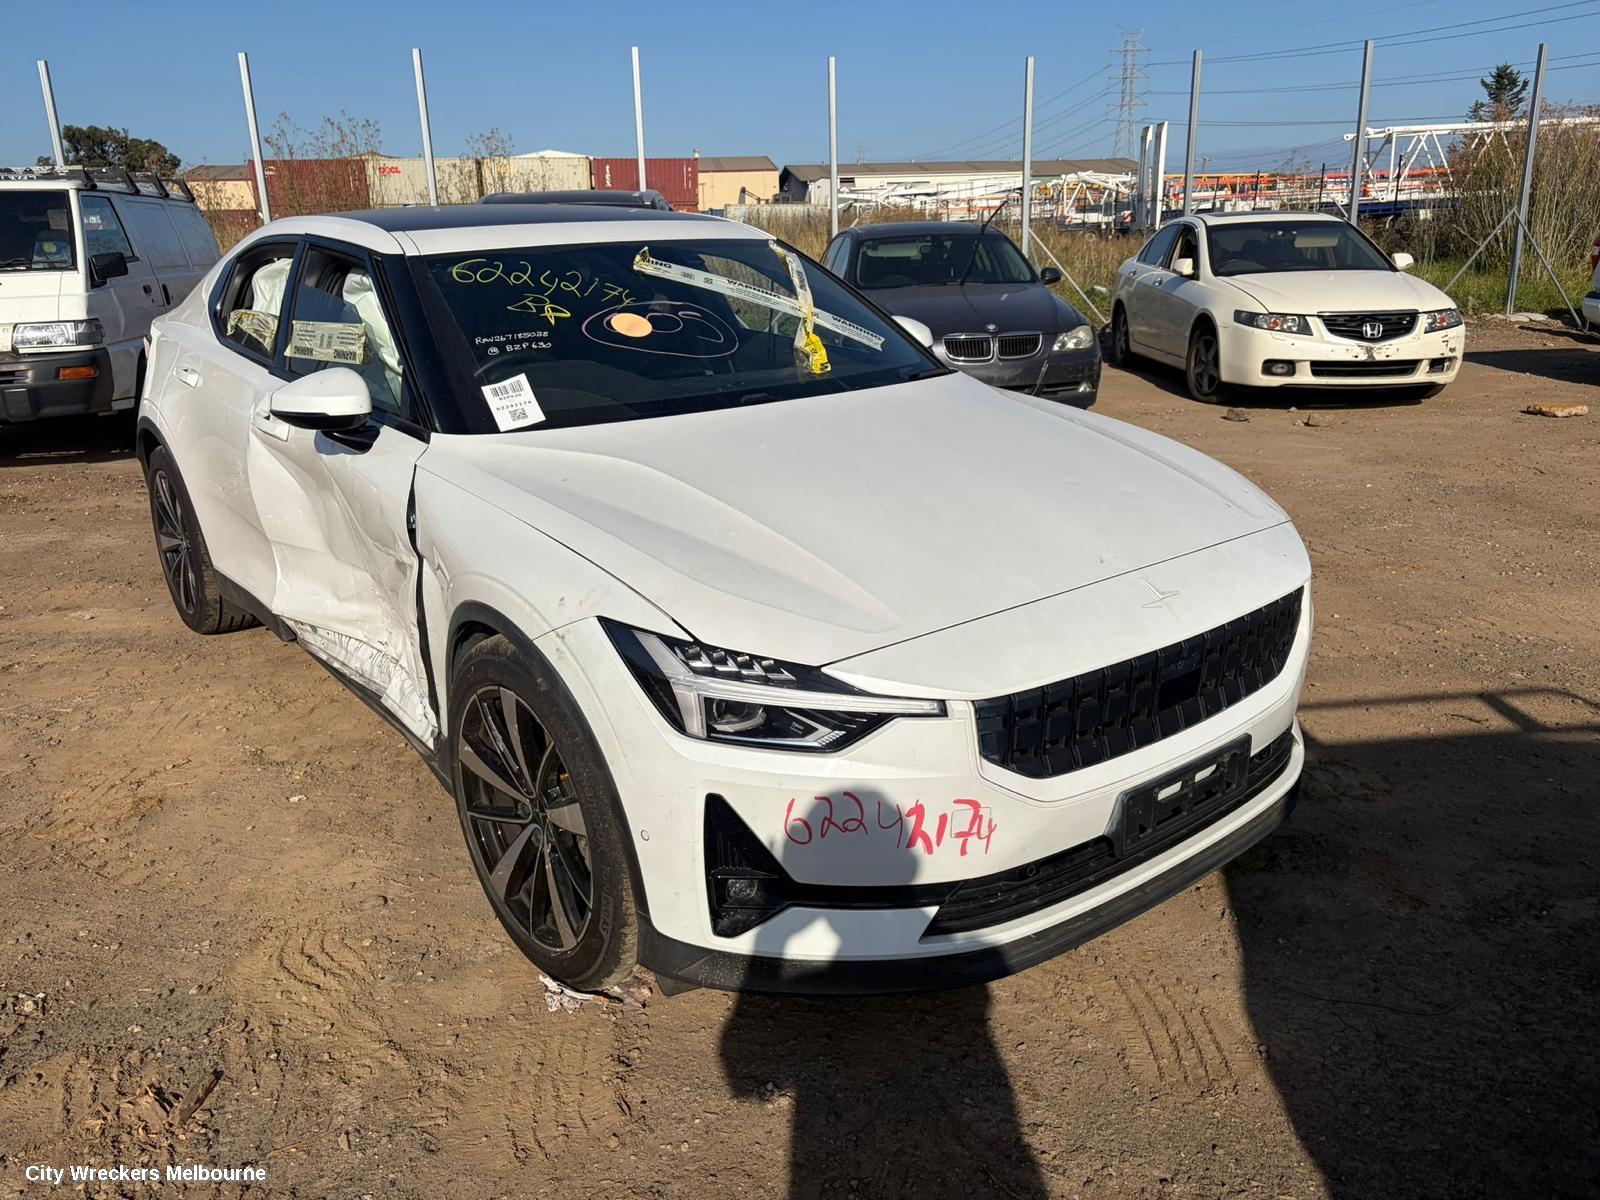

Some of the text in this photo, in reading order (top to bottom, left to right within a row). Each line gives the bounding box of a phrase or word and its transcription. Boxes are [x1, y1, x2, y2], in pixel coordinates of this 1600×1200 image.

[452, 258, 636, 310] 62242174
[727, 279, 782, 299] WARNING
[832, 315, 882, 341] WARNING
[784, 791, 997, 857] 62242174
